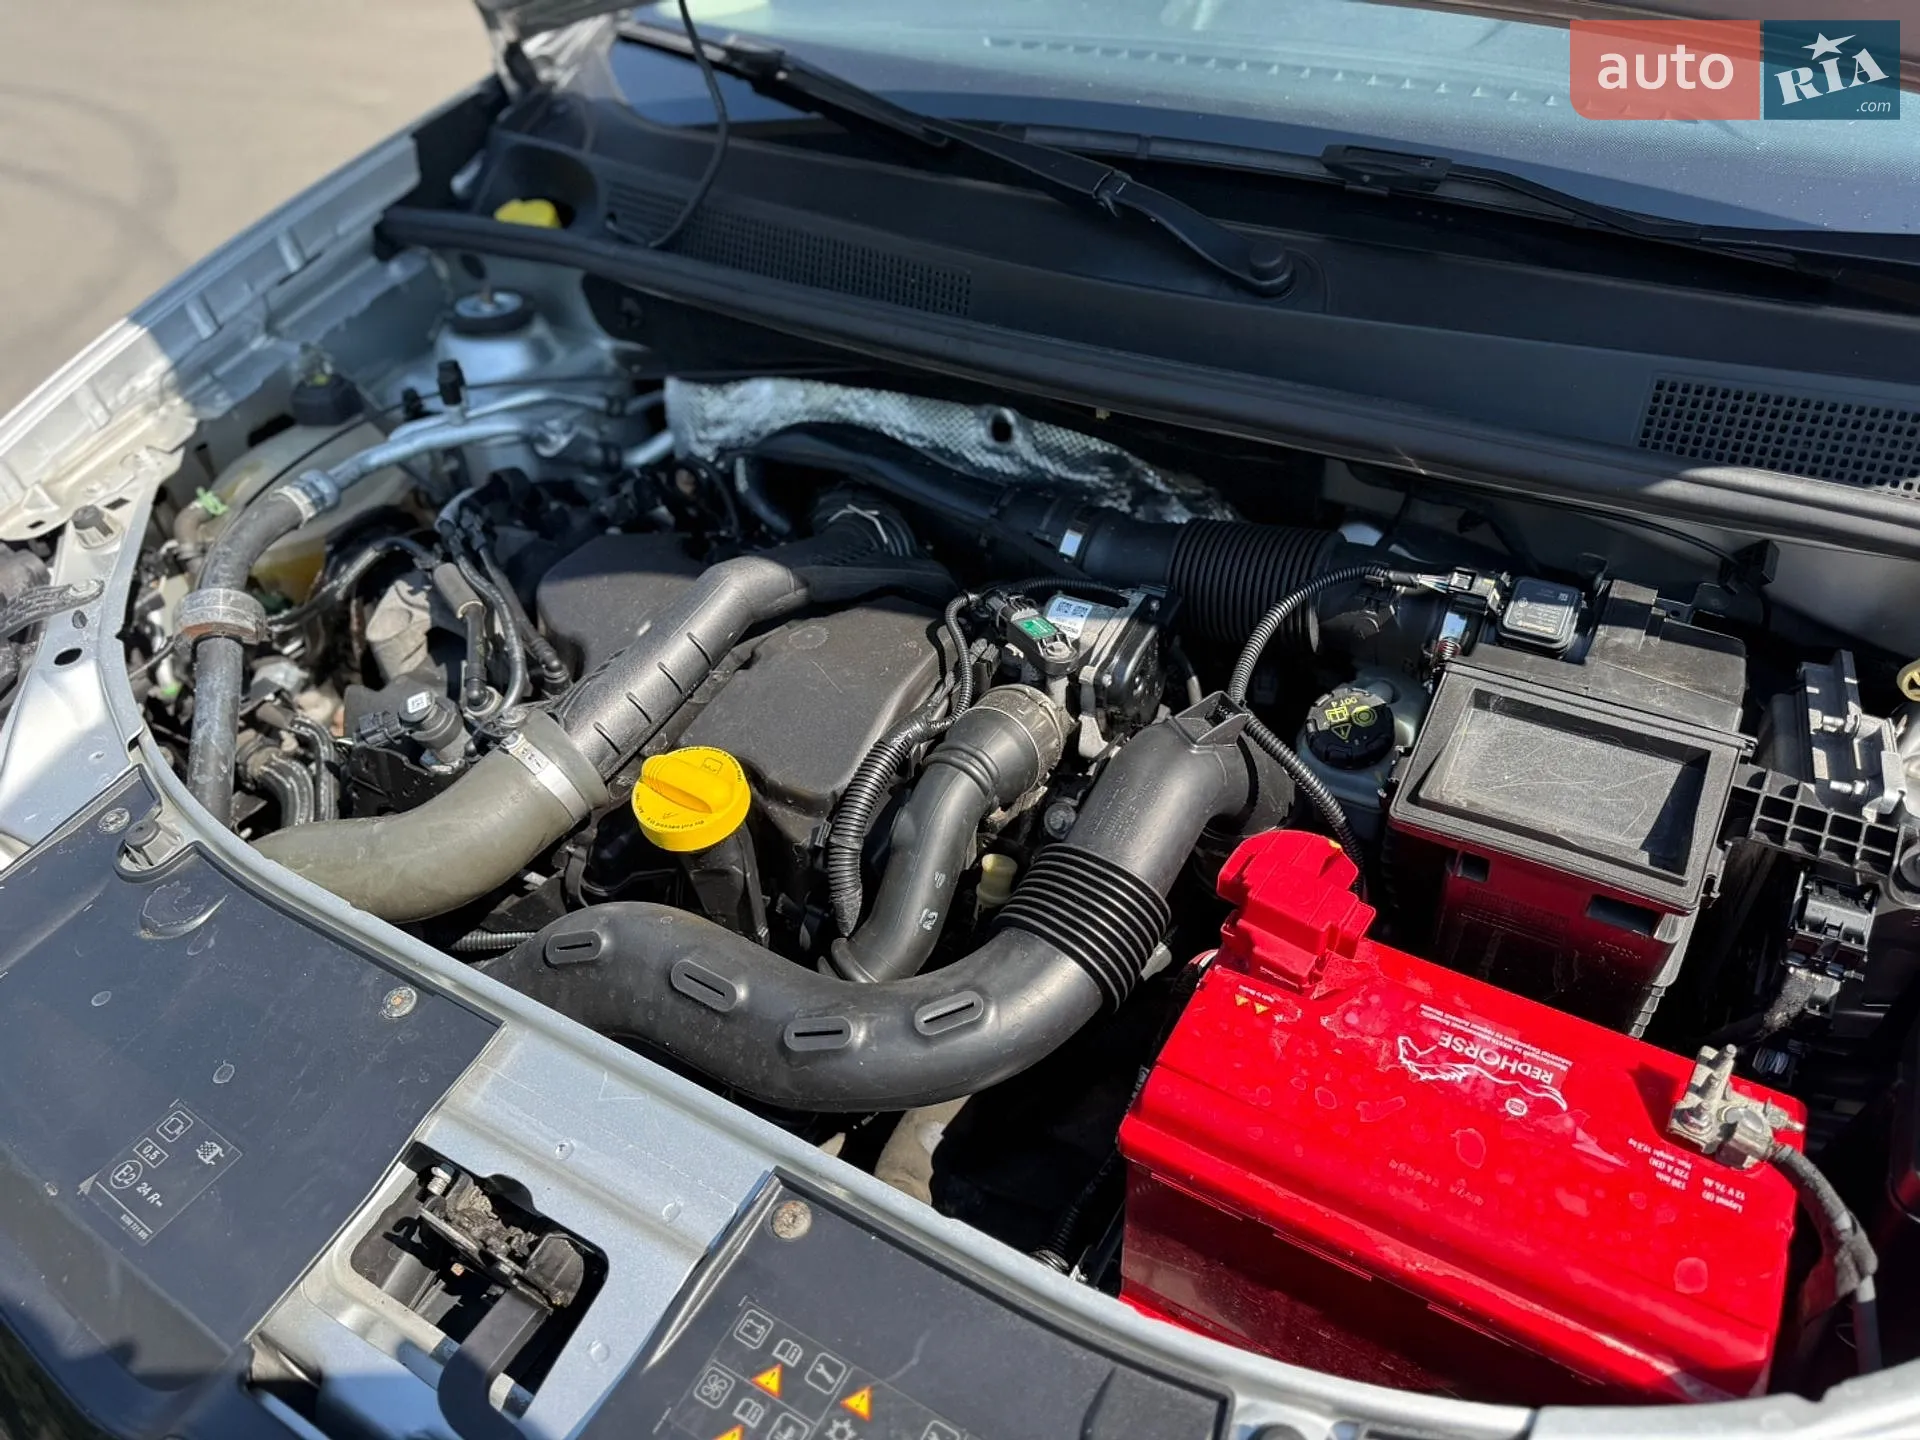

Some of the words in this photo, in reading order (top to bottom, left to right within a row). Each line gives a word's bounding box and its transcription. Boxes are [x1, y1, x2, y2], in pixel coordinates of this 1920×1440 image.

[1340, 697, 1357, 707] DOT
[1437, 1031, 1554, 1085] REDHORSE
[114, 1163, 136, 1185] E2
[137, 1182, 152, 1196] 24
